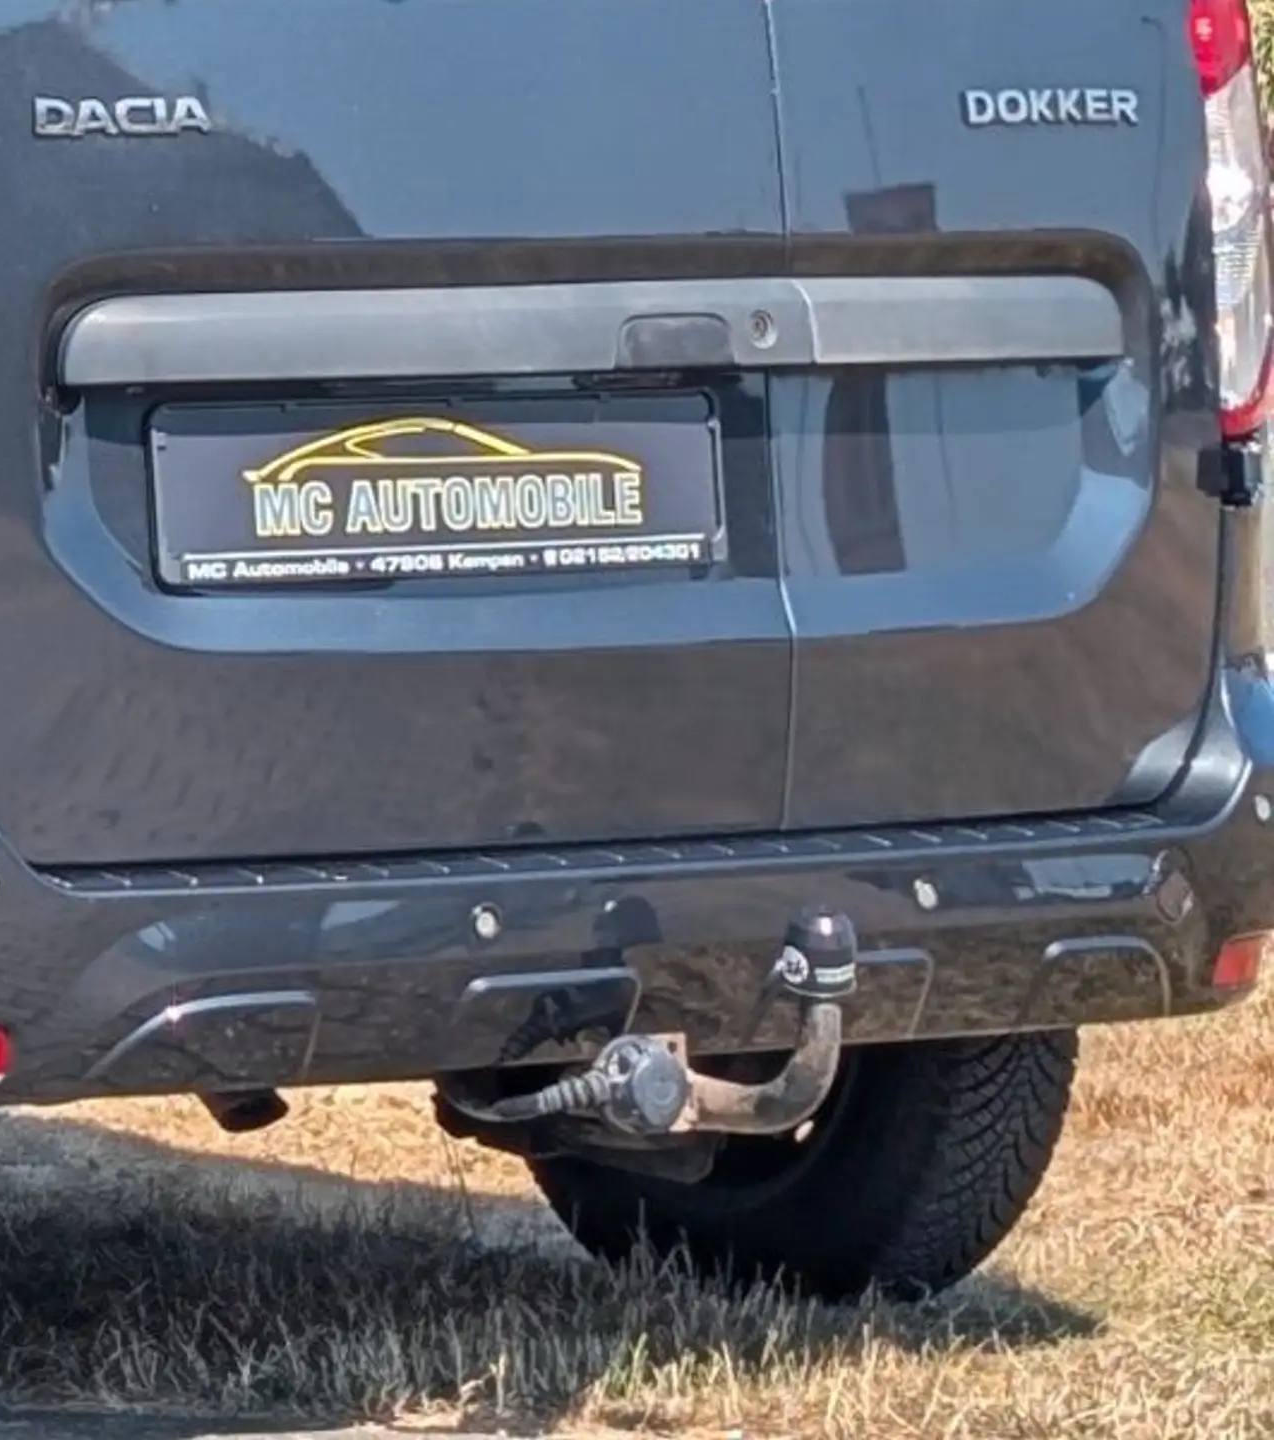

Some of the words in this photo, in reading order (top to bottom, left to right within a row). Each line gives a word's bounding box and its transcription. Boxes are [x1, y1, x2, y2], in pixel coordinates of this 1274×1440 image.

[33, 95, 212, 136] DACIA
[964, 88, 1139, 124] DOKKER
[252, 480, 334, 537] MC
[346, 472, 644, 533] AUTOMOBILE
[187, 562, 227, 580] MC
[232, 558, 349, 578] Automobile
[447, 552, 525, 571] Kempen
